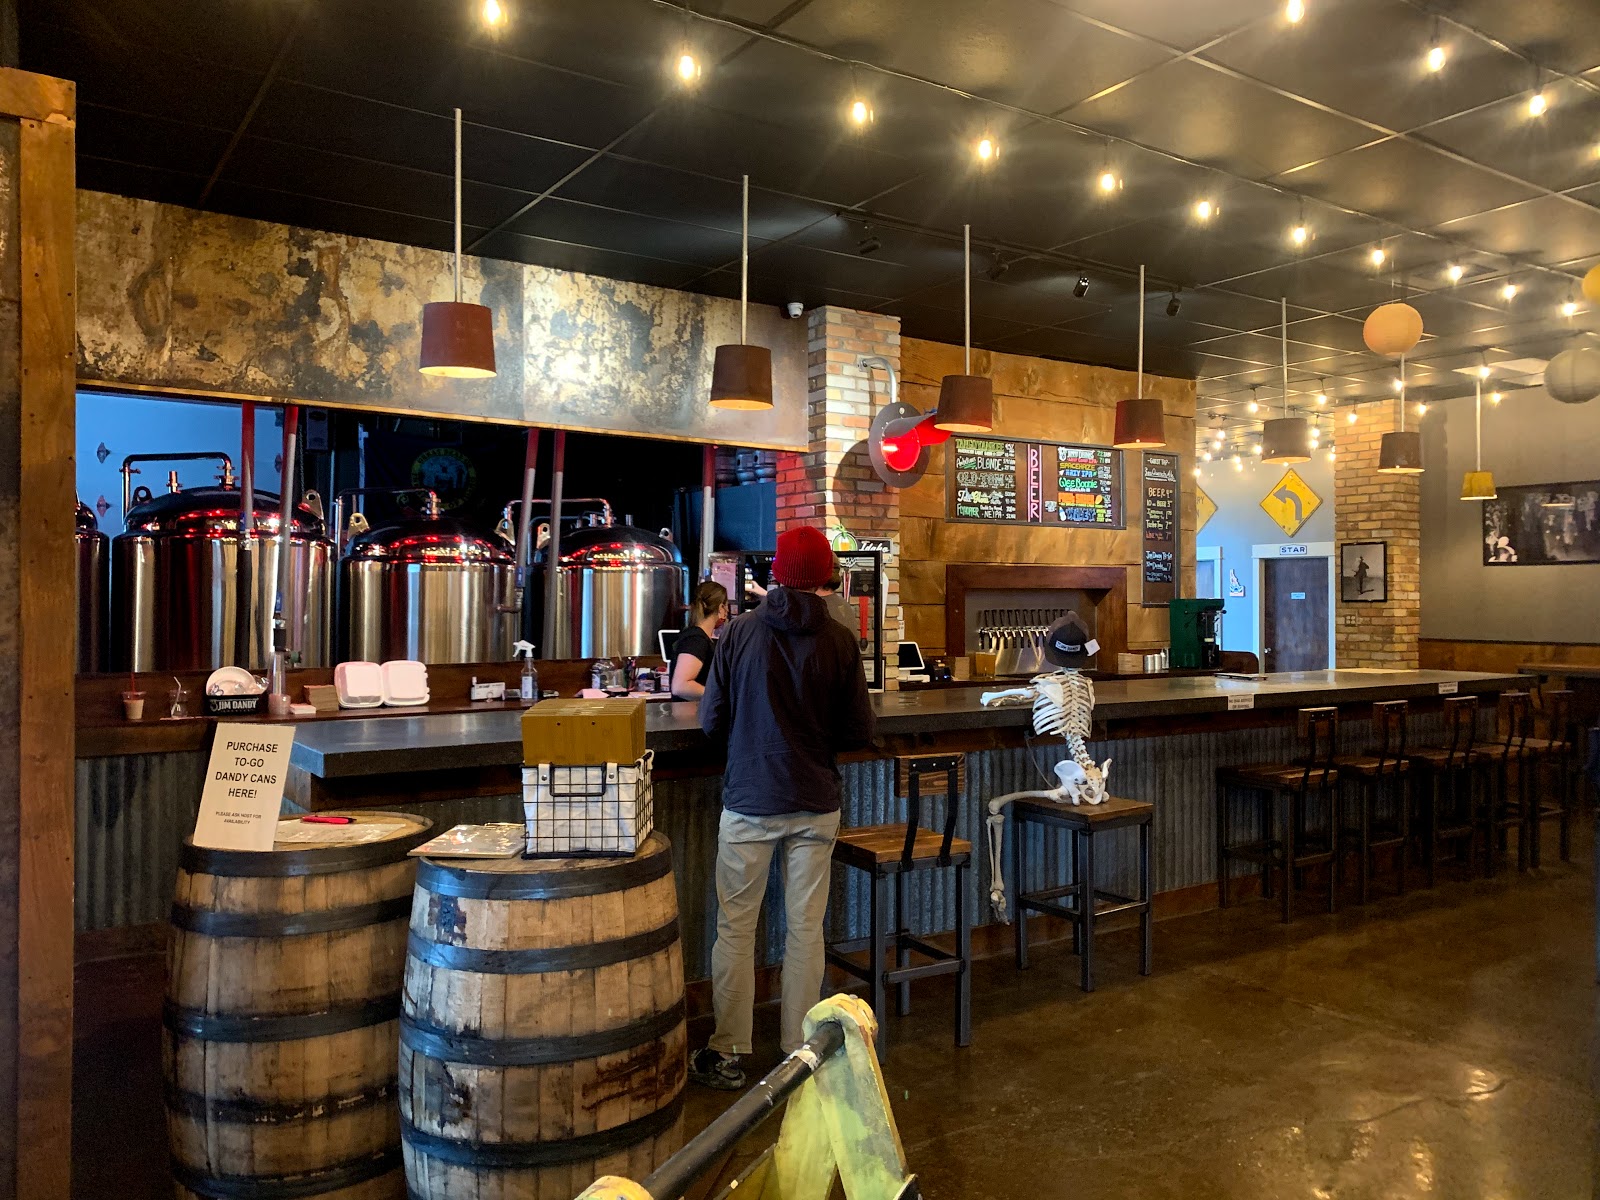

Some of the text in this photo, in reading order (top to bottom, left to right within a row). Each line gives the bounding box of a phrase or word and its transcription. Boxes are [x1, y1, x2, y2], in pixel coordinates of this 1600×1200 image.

[1030, 448, 1040, 518] BEER
[1281, 546, 1306, 554] STAR
[218, 700, 257, 711] JIM DANDY
[226, 741, 279, 753] PURCHASE
[234, 757, 265, 768] TO-GO
[215, 771, 277, 784] DANDY CANS
[228, 788, 258, 798] HERE!
